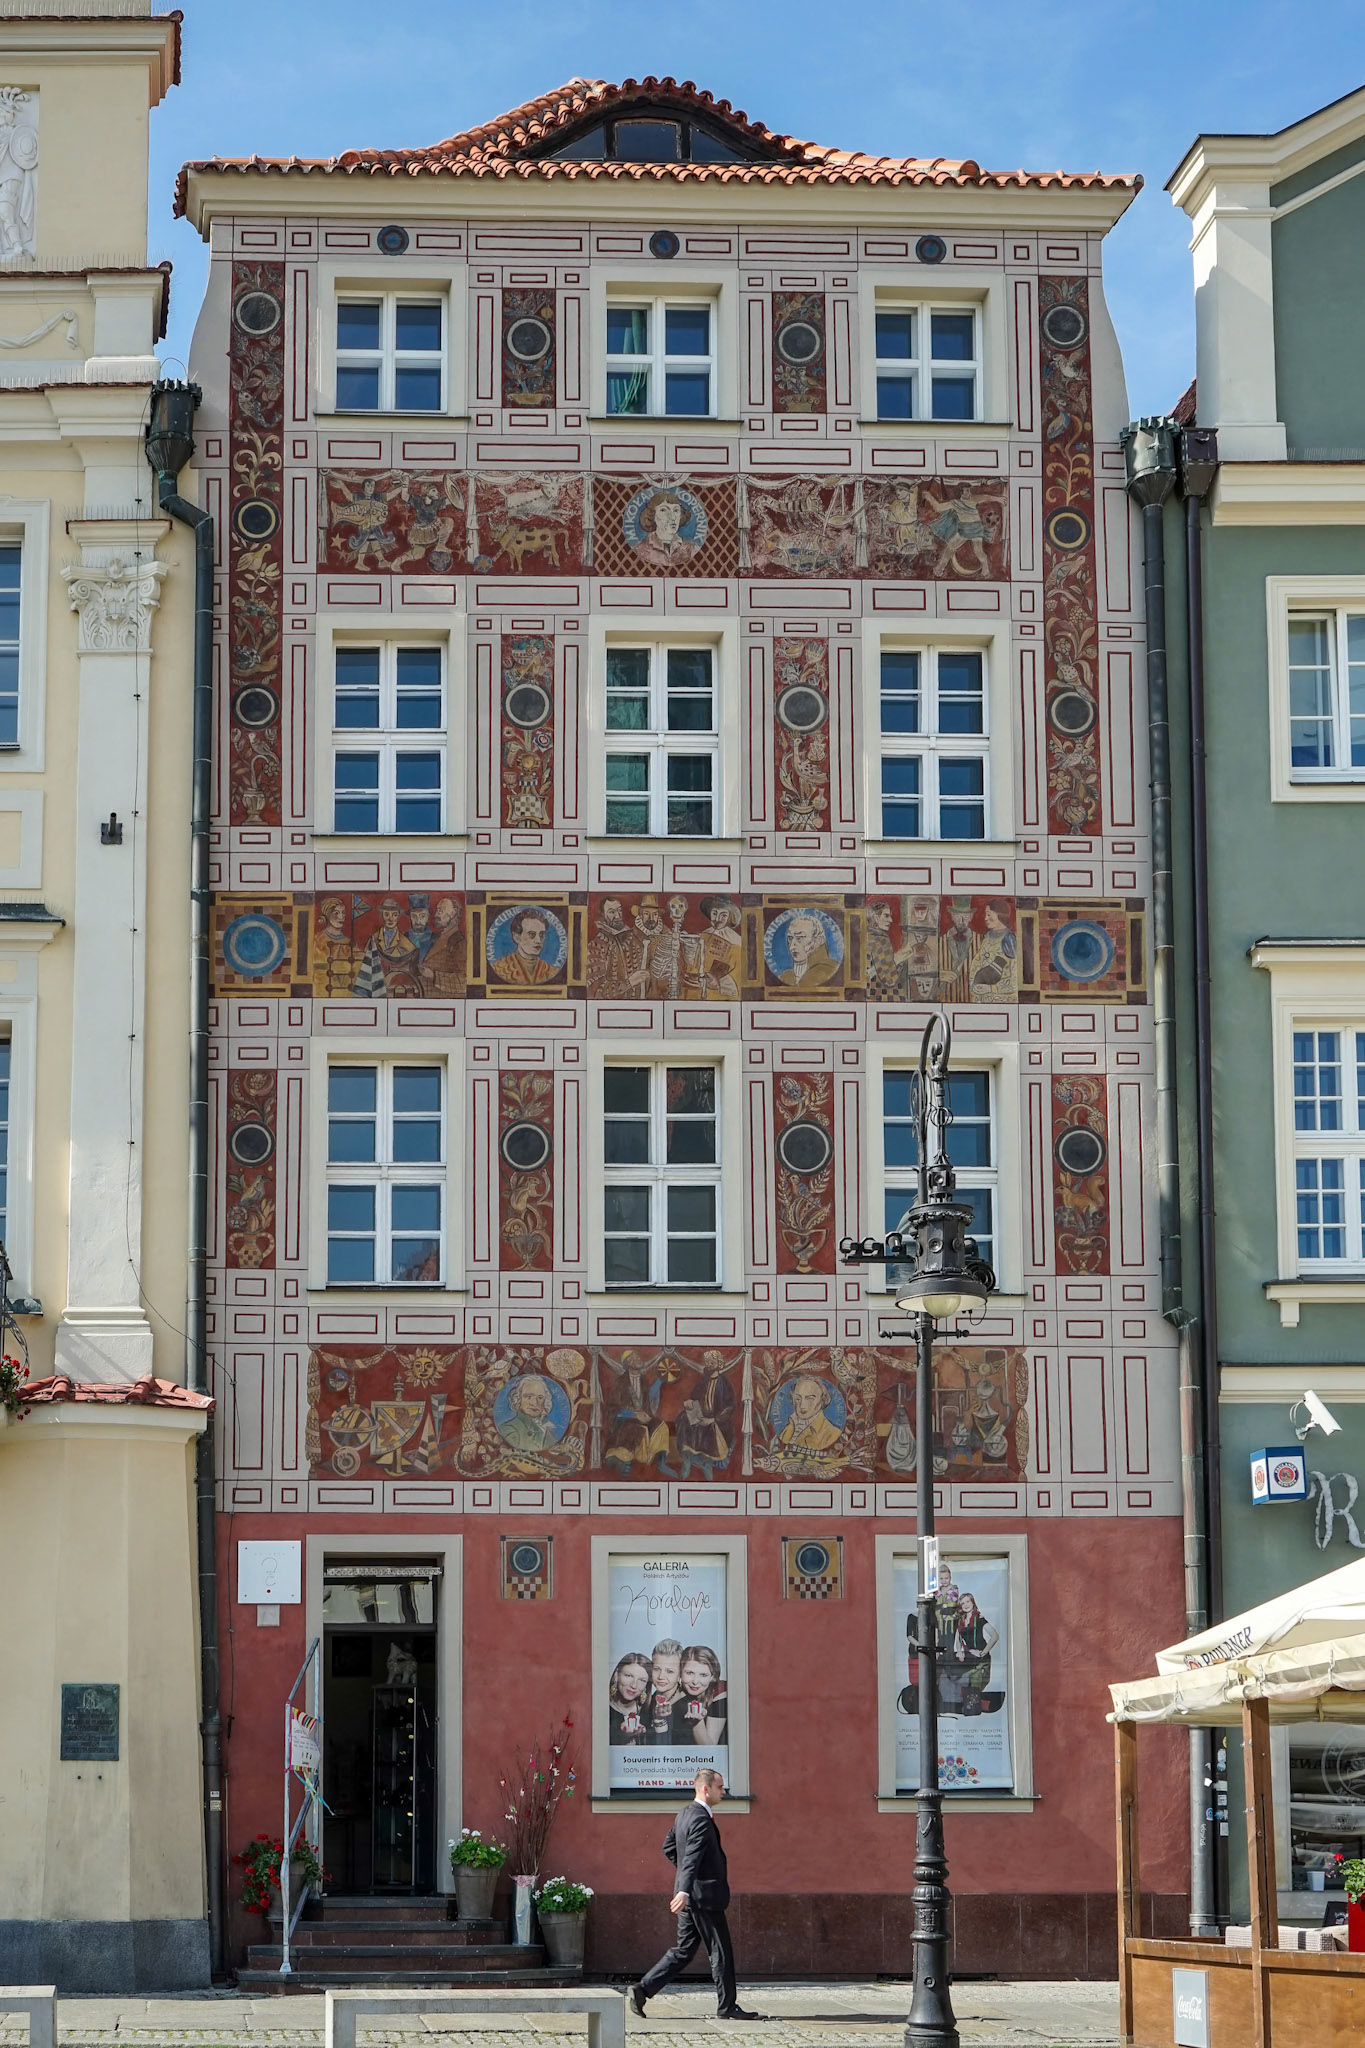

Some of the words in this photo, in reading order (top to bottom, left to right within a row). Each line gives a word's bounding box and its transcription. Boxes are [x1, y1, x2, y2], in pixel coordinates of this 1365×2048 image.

[675, 487, 707, 542] KOPERNIK
[486, 927, 498, 961] MARIA
[494, 906, 522, 927] CURIE
[643, 1562, 689, 1571] GALERIA
